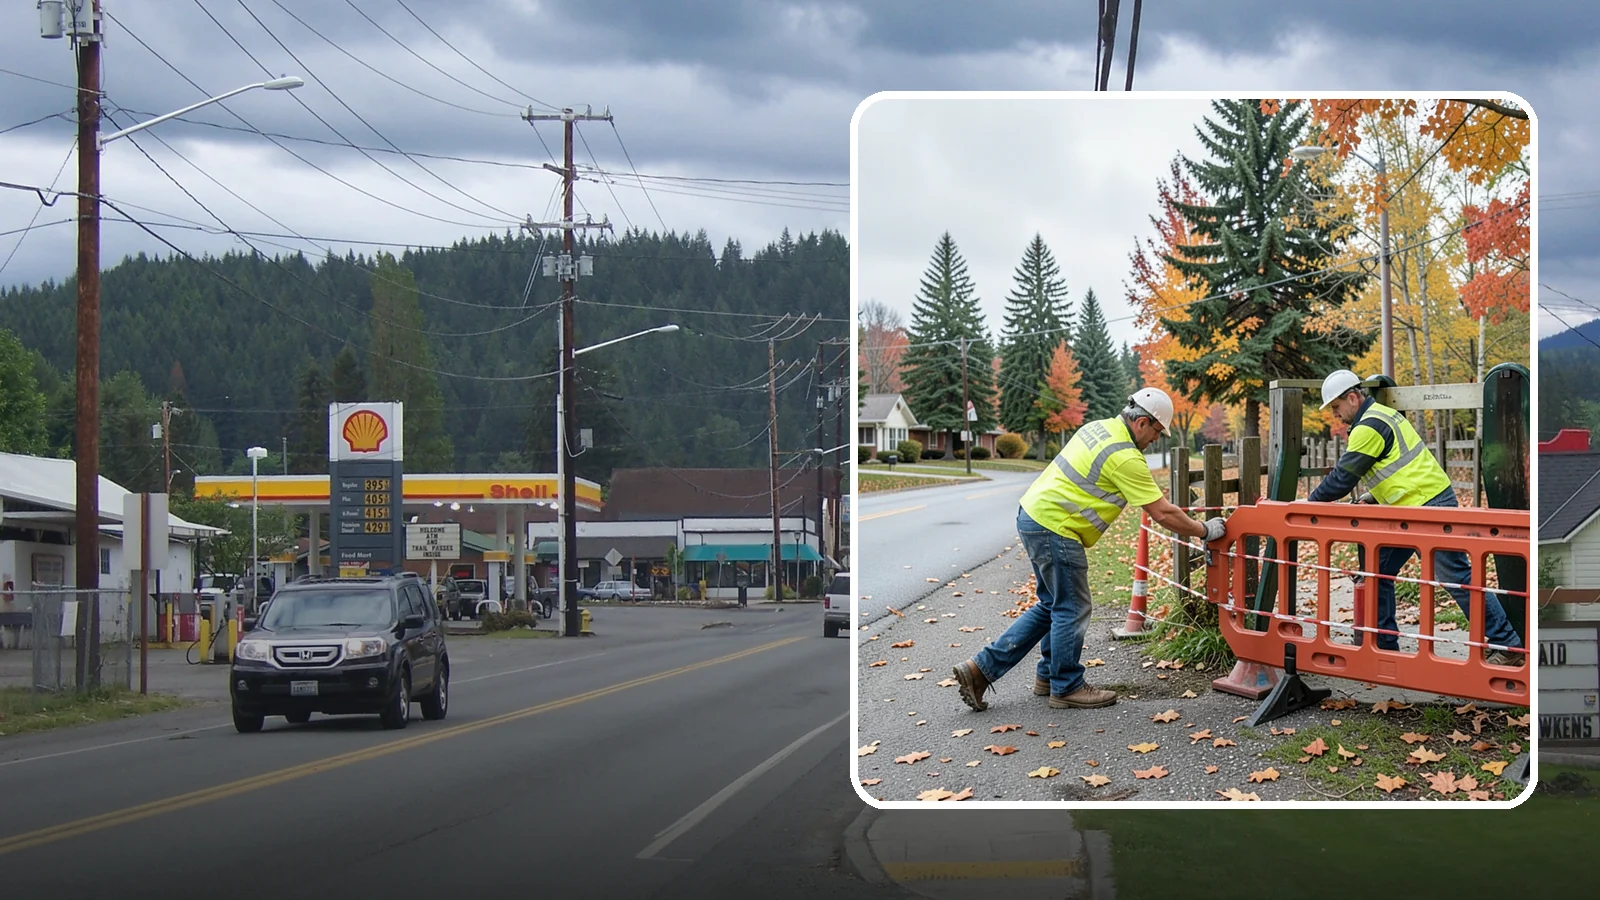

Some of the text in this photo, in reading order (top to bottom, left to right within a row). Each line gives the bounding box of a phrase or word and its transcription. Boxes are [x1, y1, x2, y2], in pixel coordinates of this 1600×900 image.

[366, 480, 384, 490] 395
[490, 484, 547, 499] Shell
[365, 494, 384, 504] 405
[365, 508, 384, 518] 415
[365, 522, 384, 533] 429
